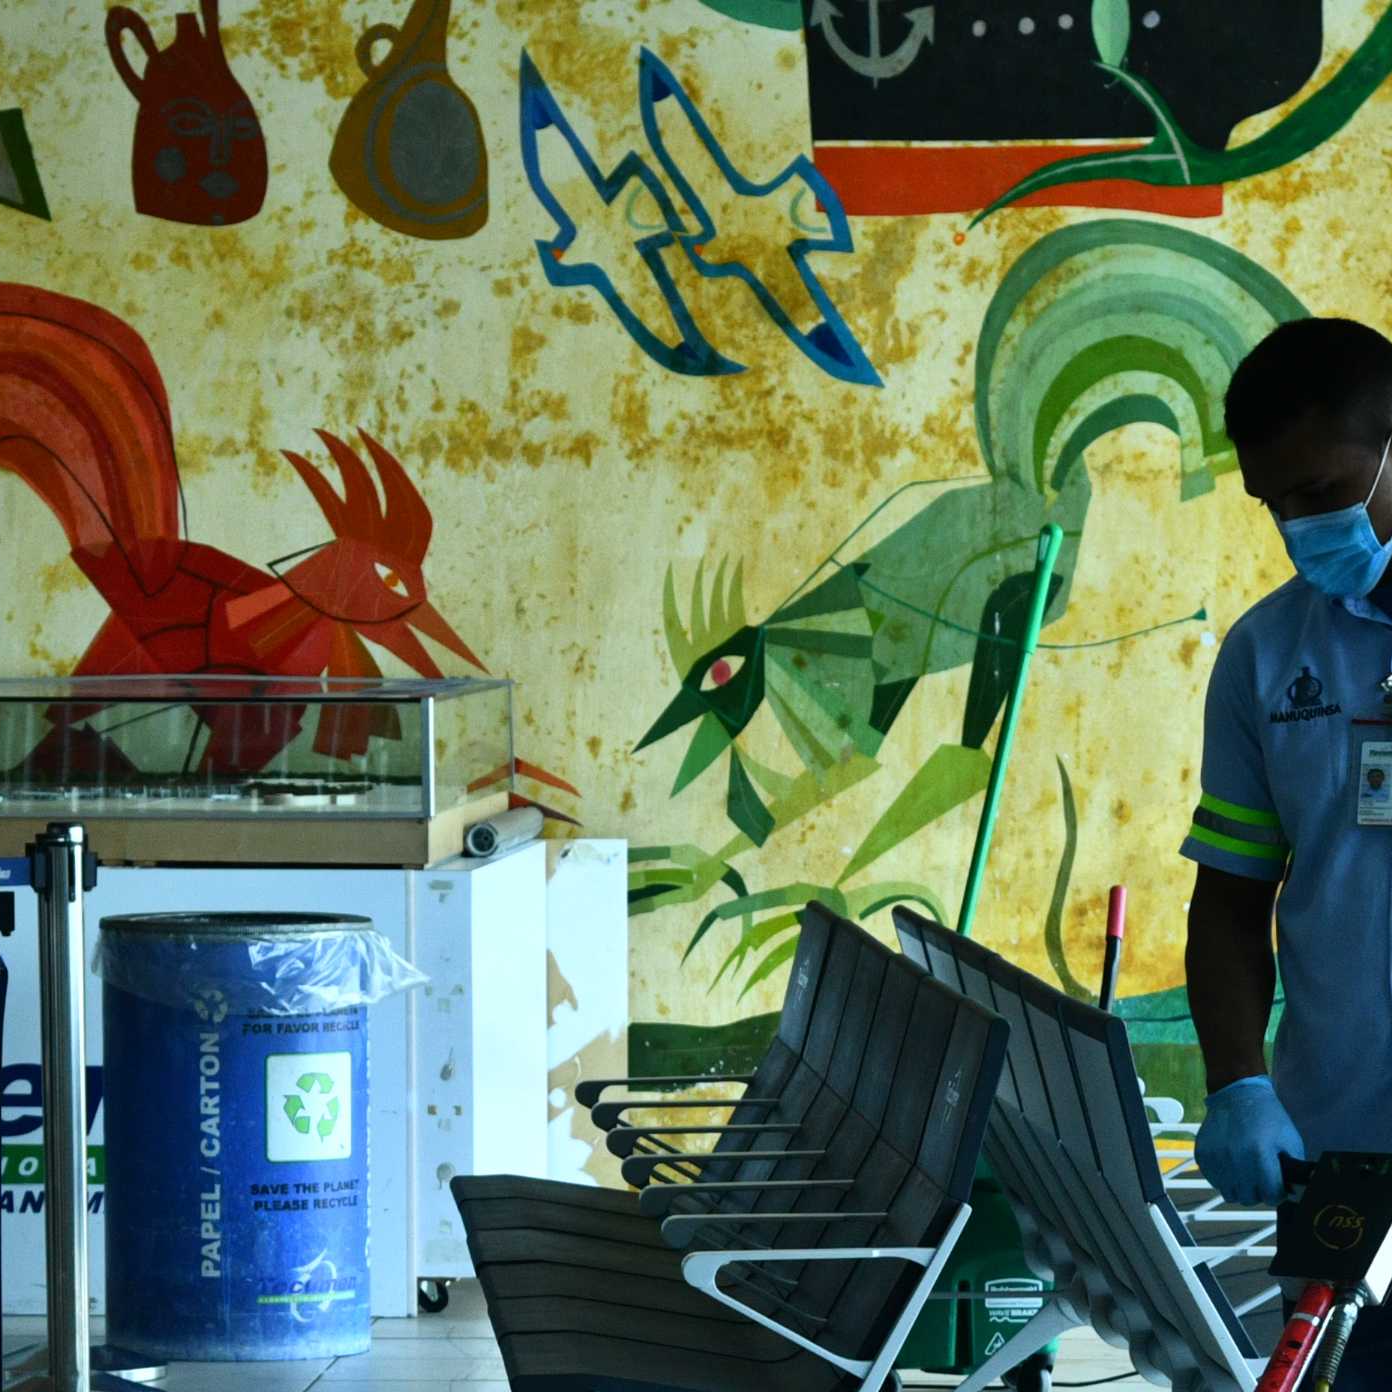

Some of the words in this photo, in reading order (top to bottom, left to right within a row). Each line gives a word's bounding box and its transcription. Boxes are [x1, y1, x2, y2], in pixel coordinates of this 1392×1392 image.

[1270, 704, 1342, 723] MANUQUINSA
[276, 1022, 319, 1034] FAVOR
[200, 1033, 221, 1157] CARTON
[250, 1183, 289, 1196] SAVE
[293, 1182, 319, 1195] THE
[323, 1179, 360, 1192] PLANET
[254, 1199, 309, 1212] PLEASE
[313, 1195, 359, 1209] RECYCLE
[200, 1184, 221, 1278] PAPEL
